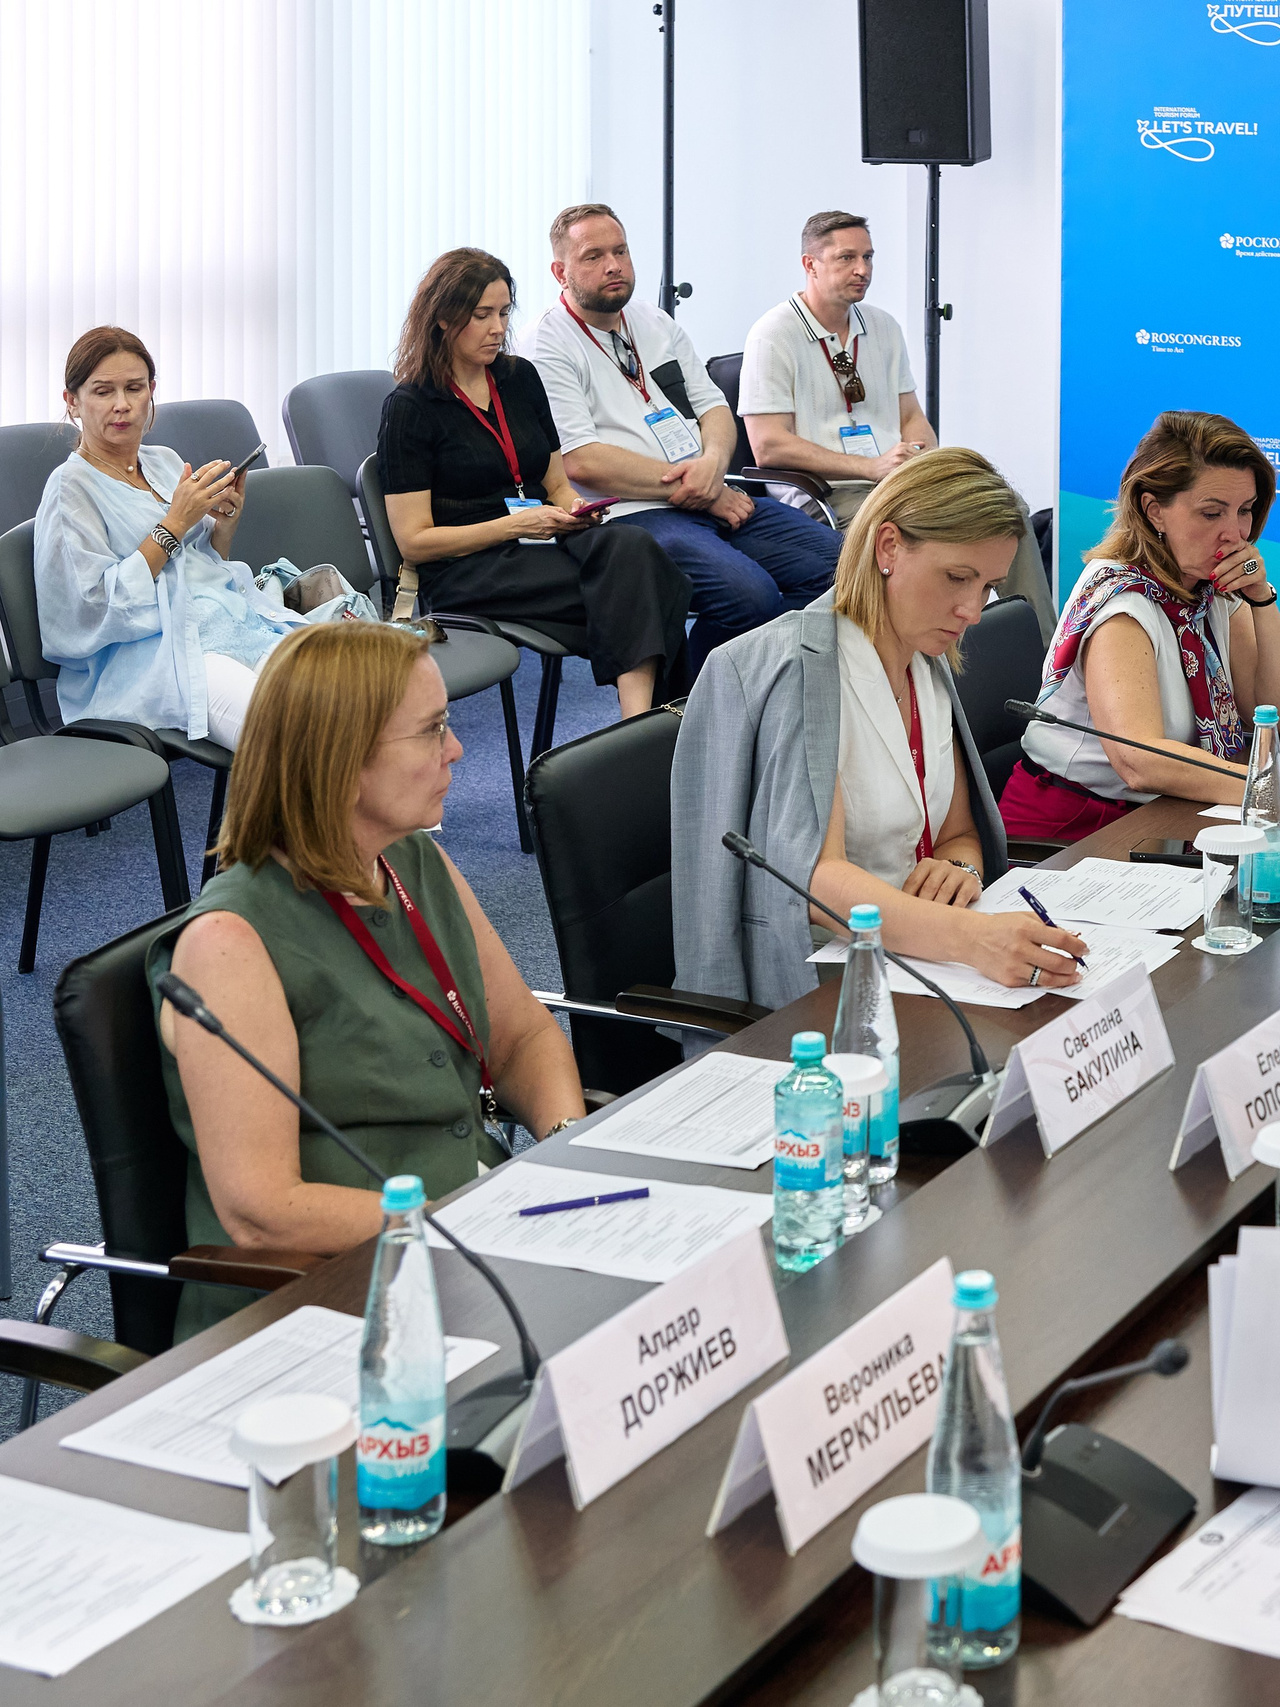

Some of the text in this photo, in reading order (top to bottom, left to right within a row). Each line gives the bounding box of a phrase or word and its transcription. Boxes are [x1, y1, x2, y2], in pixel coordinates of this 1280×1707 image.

[1153, 120, 1258, 136] LET'S TRAVEL!
[1151, 332, 1242, 347] ROSCONGRESS
[1063, 1008, 1123, 1059] Светлана
[1064, 1031, 1143, 1103] БАКУЛИНА
[638, 1306, 701, 1364] Алдар
[620, 1327, 738, 1438] ДОРЖИЕВ
[823, 1332, 915, 1416] Вероника
